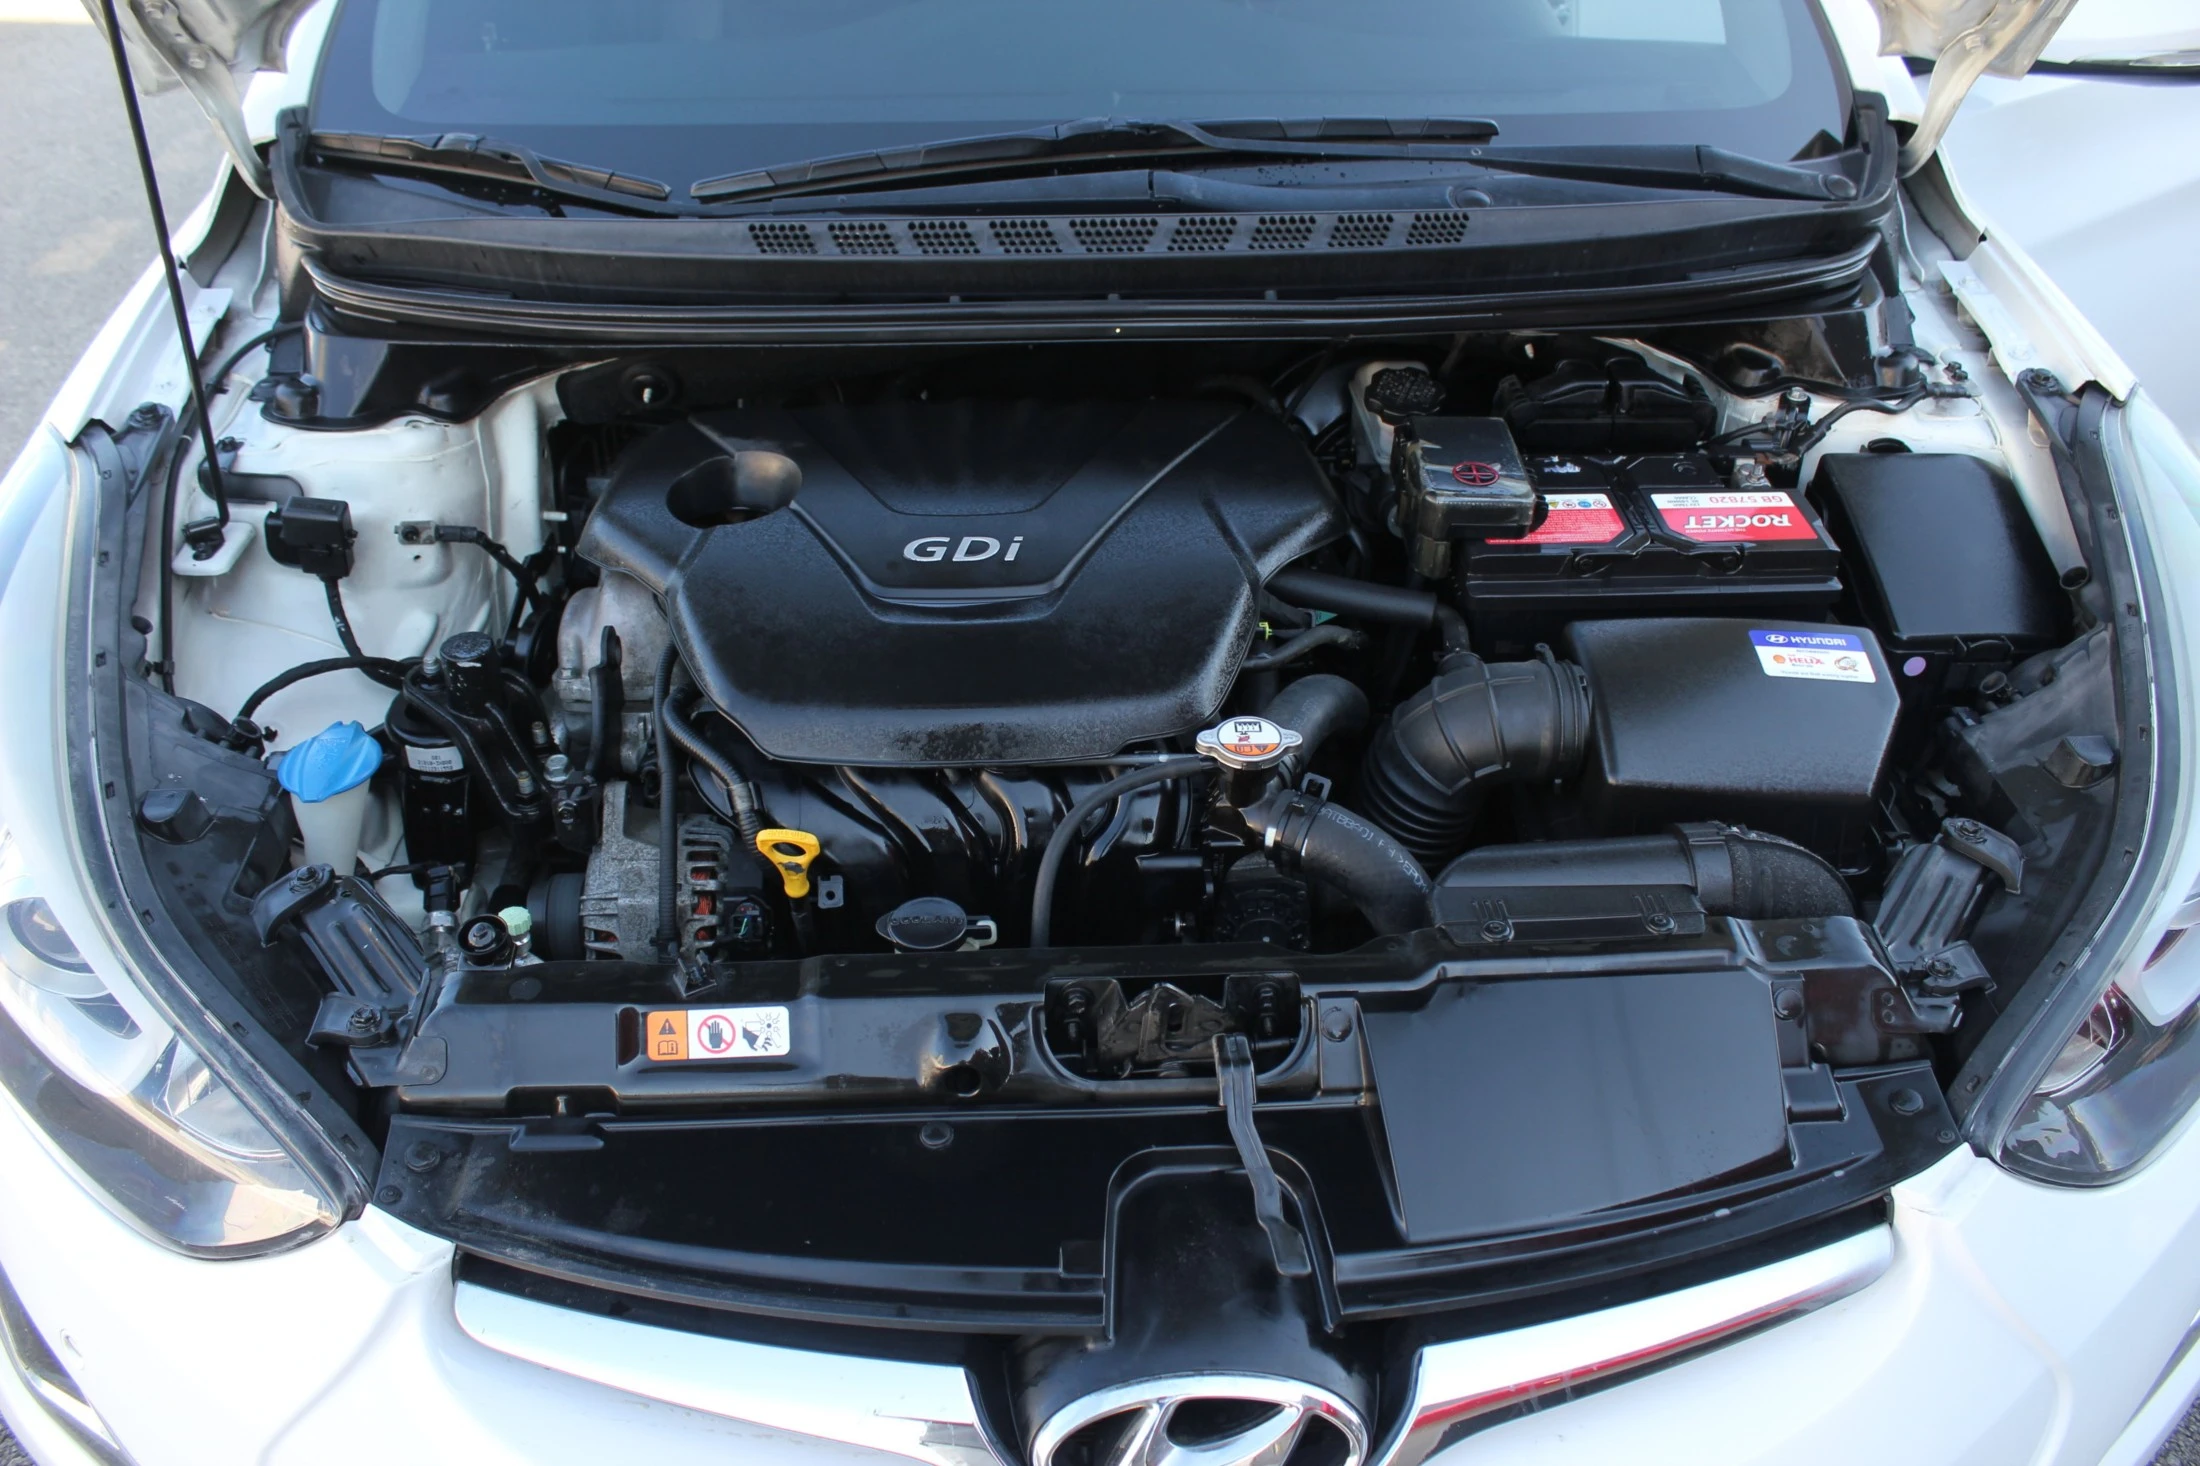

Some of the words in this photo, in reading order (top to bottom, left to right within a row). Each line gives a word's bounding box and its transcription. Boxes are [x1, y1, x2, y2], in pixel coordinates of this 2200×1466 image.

[1709, 495, 1757, 504] 57820
[1761, 495, 1783, 503] GB
[1684, 514, 1792, 528] ROCKET
[903, 536, 1024, 562] GDi
[1790, 636, 1847, 646] HYUNDAI
[1789, 655, 1824, 664] HELIX
